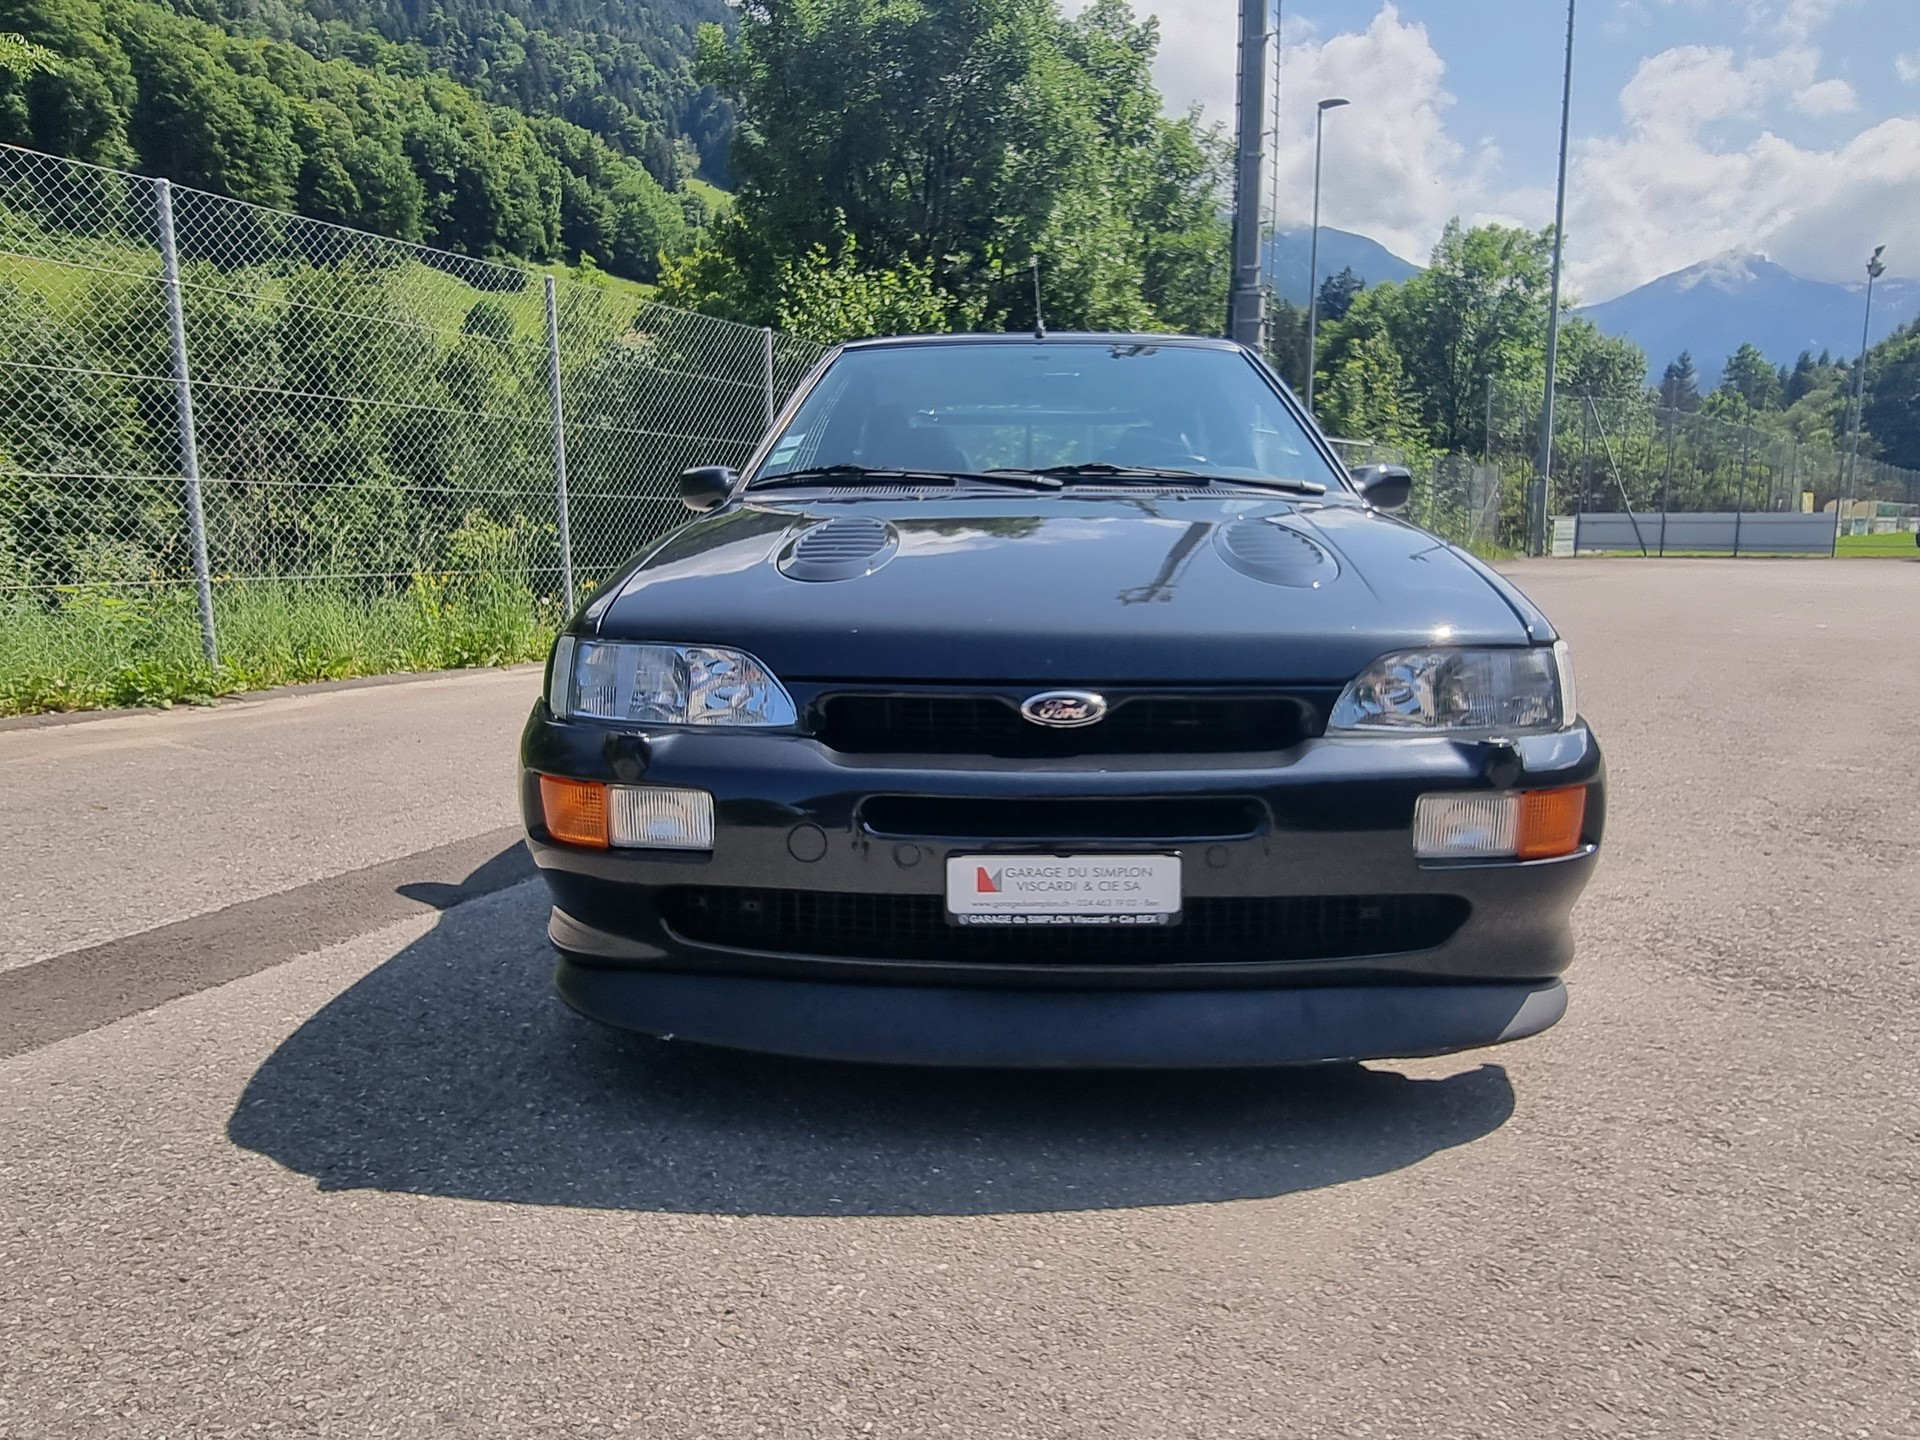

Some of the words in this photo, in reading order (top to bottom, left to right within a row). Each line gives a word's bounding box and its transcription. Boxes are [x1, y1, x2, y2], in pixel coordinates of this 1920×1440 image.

[1039, 699, 1088, 718] Ford
[1005, 867, 1062, 878] GARAGE
[1068, 867, 1087, 877] DU
[1092, 867, 1153, 877] SIMPLON
[1016, 881, 1077, 892] VISCARDI
[1083, 881, 1093, 891] &
[1098, 881, 1119, 891] CIE
[1123, 881, 1141, 891] SA
[969, 914, 1012, 924] GARAGE
